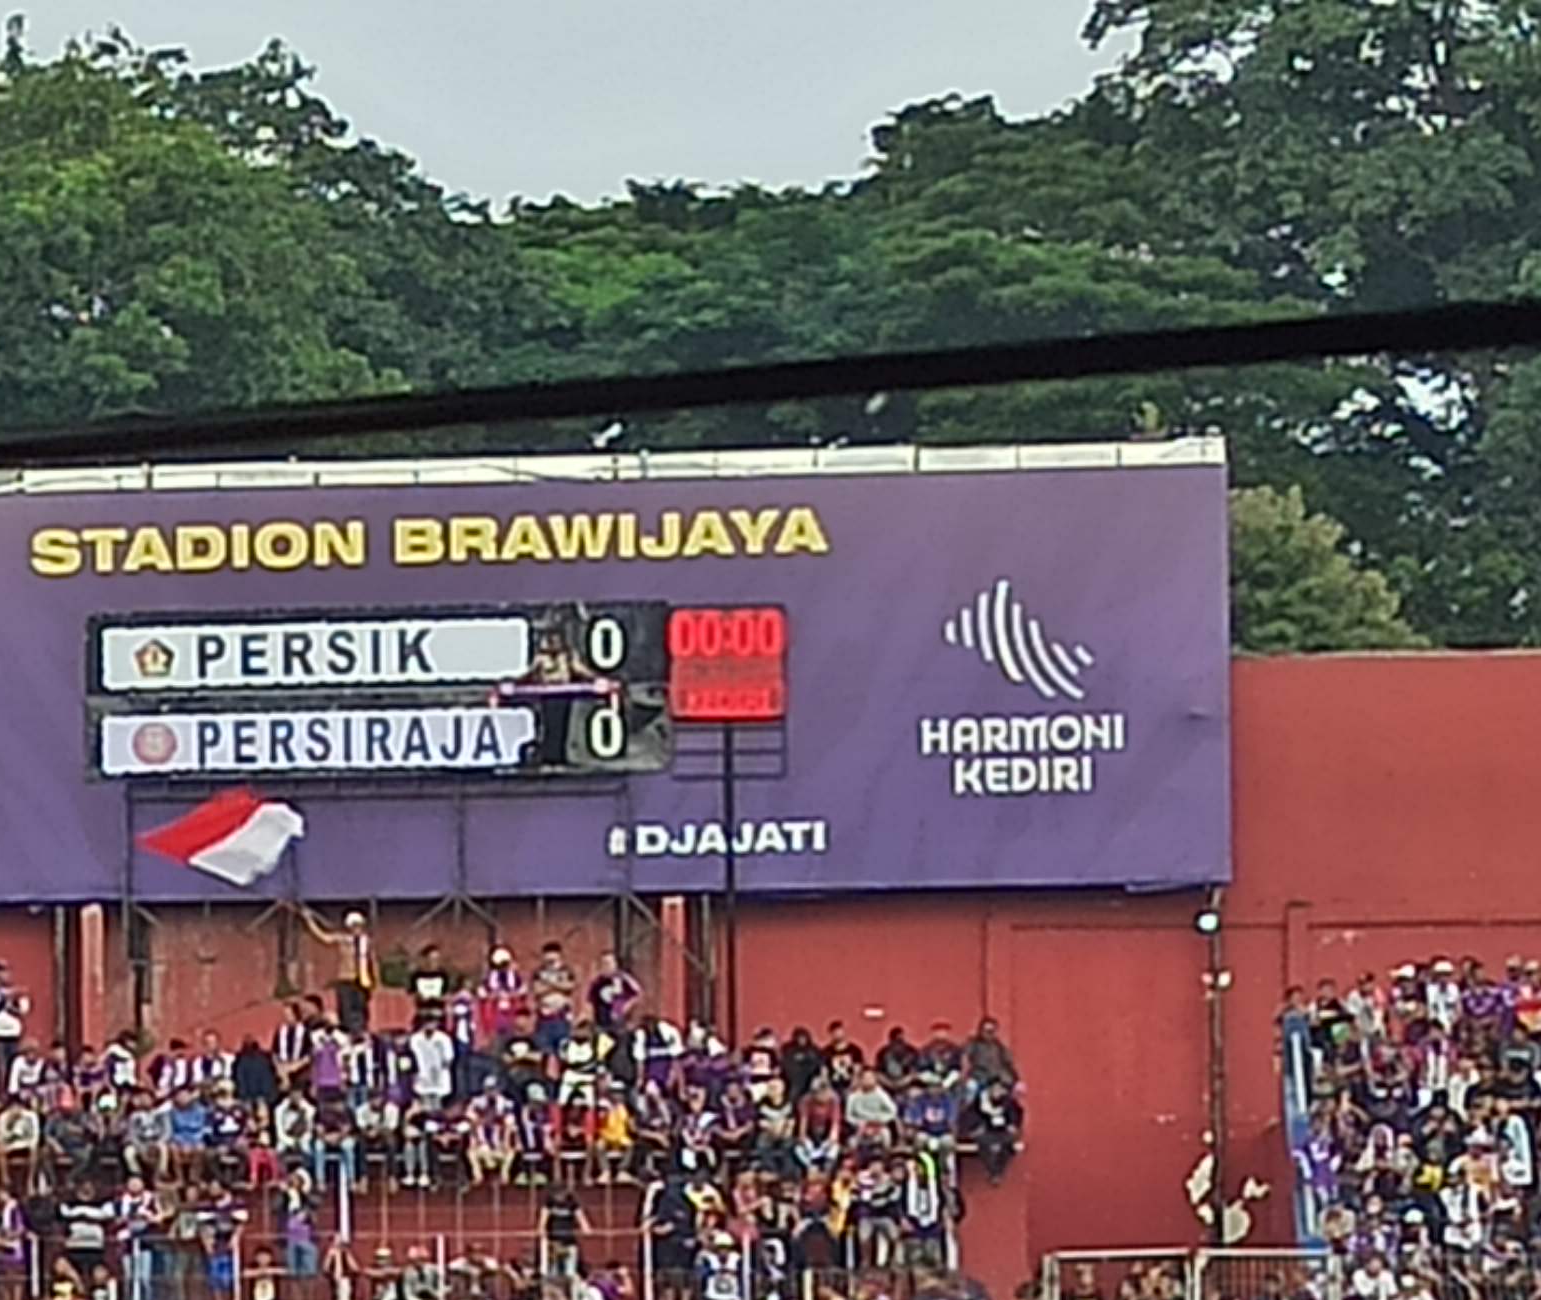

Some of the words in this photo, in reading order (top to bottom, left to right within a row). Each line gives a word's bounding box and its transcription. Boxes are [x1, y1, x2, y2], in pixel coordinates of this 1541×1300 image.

[30, 519, 367, 577] STADION
[393, 506, 830, 566] BRAWIJAYA
[197, 626, 434, 679] PERSIK
[590, 618, 624, 670] 0
[670, 609, 785, 656] 00:00
[197, 714, 505, 772] PERSIRAJA
[590, 708, 624, 758] 0
[920, 712, 1124, 755] HARMONI
[953, 755, 1093, 795] KEDIRI
[609, 819, 827, 858] #DJAJATI
